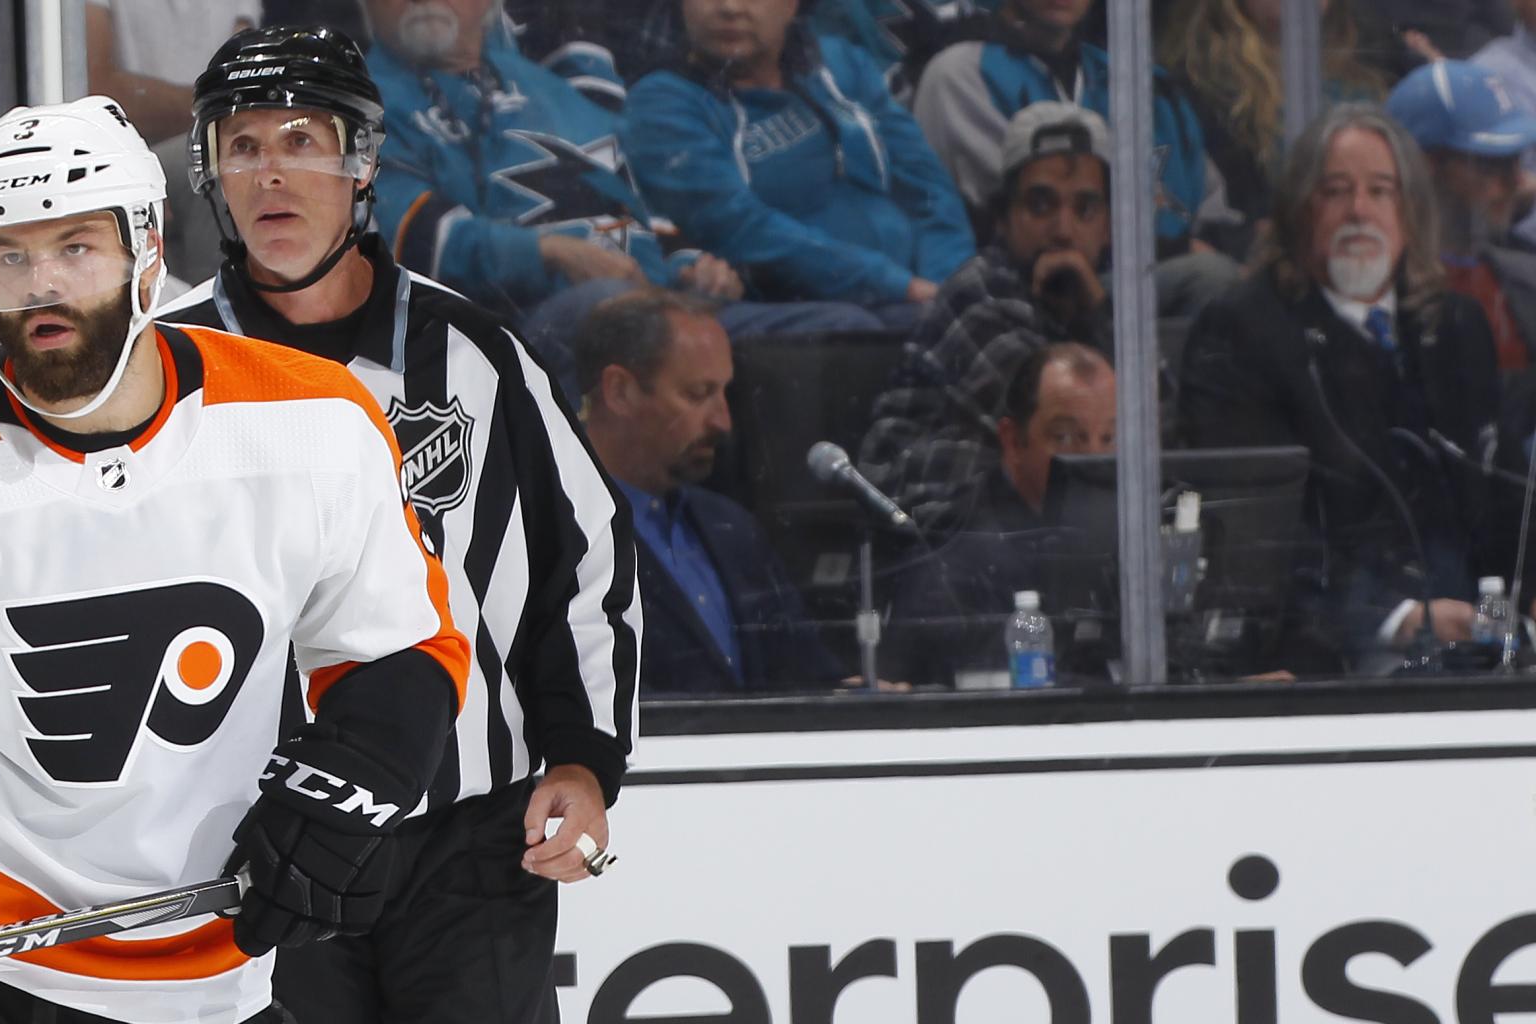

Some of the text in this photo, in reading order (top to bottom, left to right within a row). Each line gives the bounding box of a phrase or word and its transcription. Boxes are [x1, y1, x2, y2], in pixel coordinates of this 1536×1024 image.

[227, 65, 286, 81] BAUER
[13, 118, 41, 141] 3
[404, 430, 459, 486] NHL
